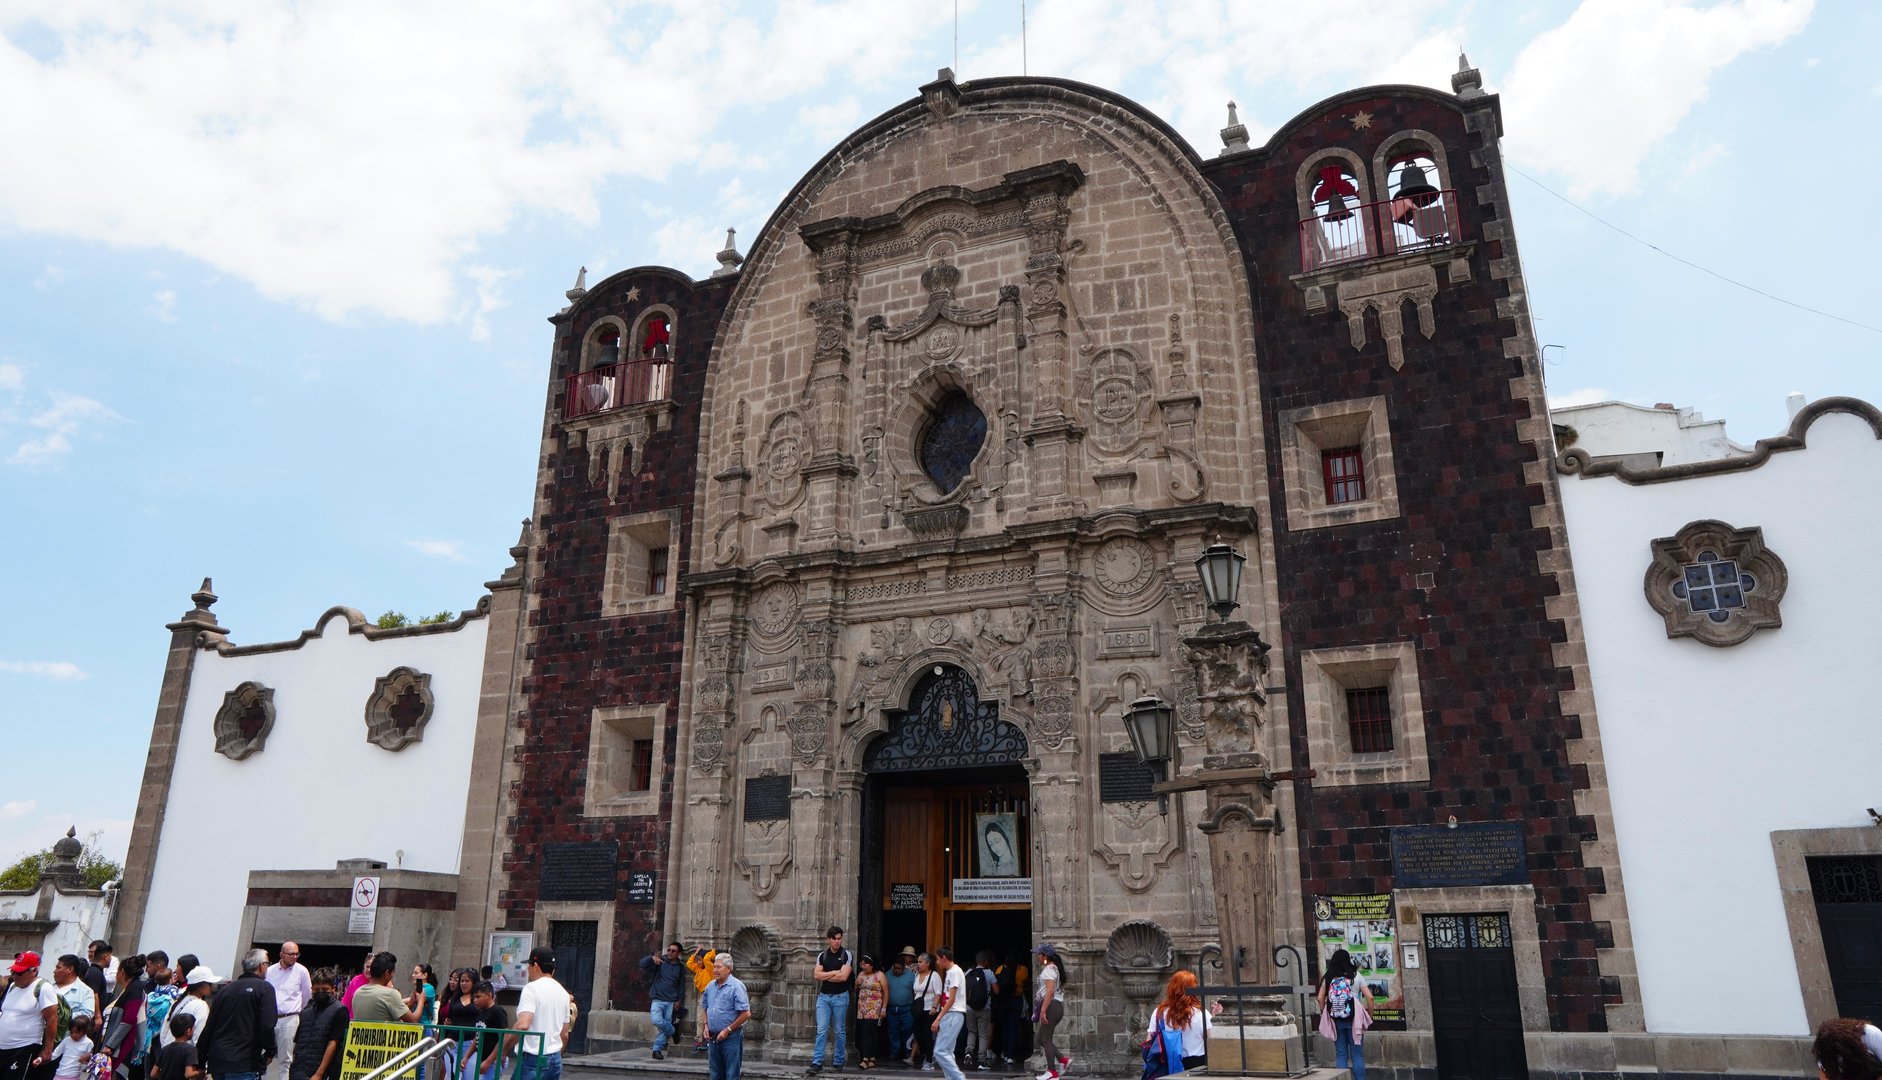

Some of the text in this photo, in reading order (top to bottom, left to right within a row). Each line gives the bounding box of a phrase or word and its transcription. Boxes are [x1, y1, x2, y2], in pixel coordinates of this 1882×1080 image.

[1108, 632, 1146, 646] 1950
[350, 1028, 418, 1048] PROHIBIDA LA VENTA
[356, 1049, 361, 1068] A
